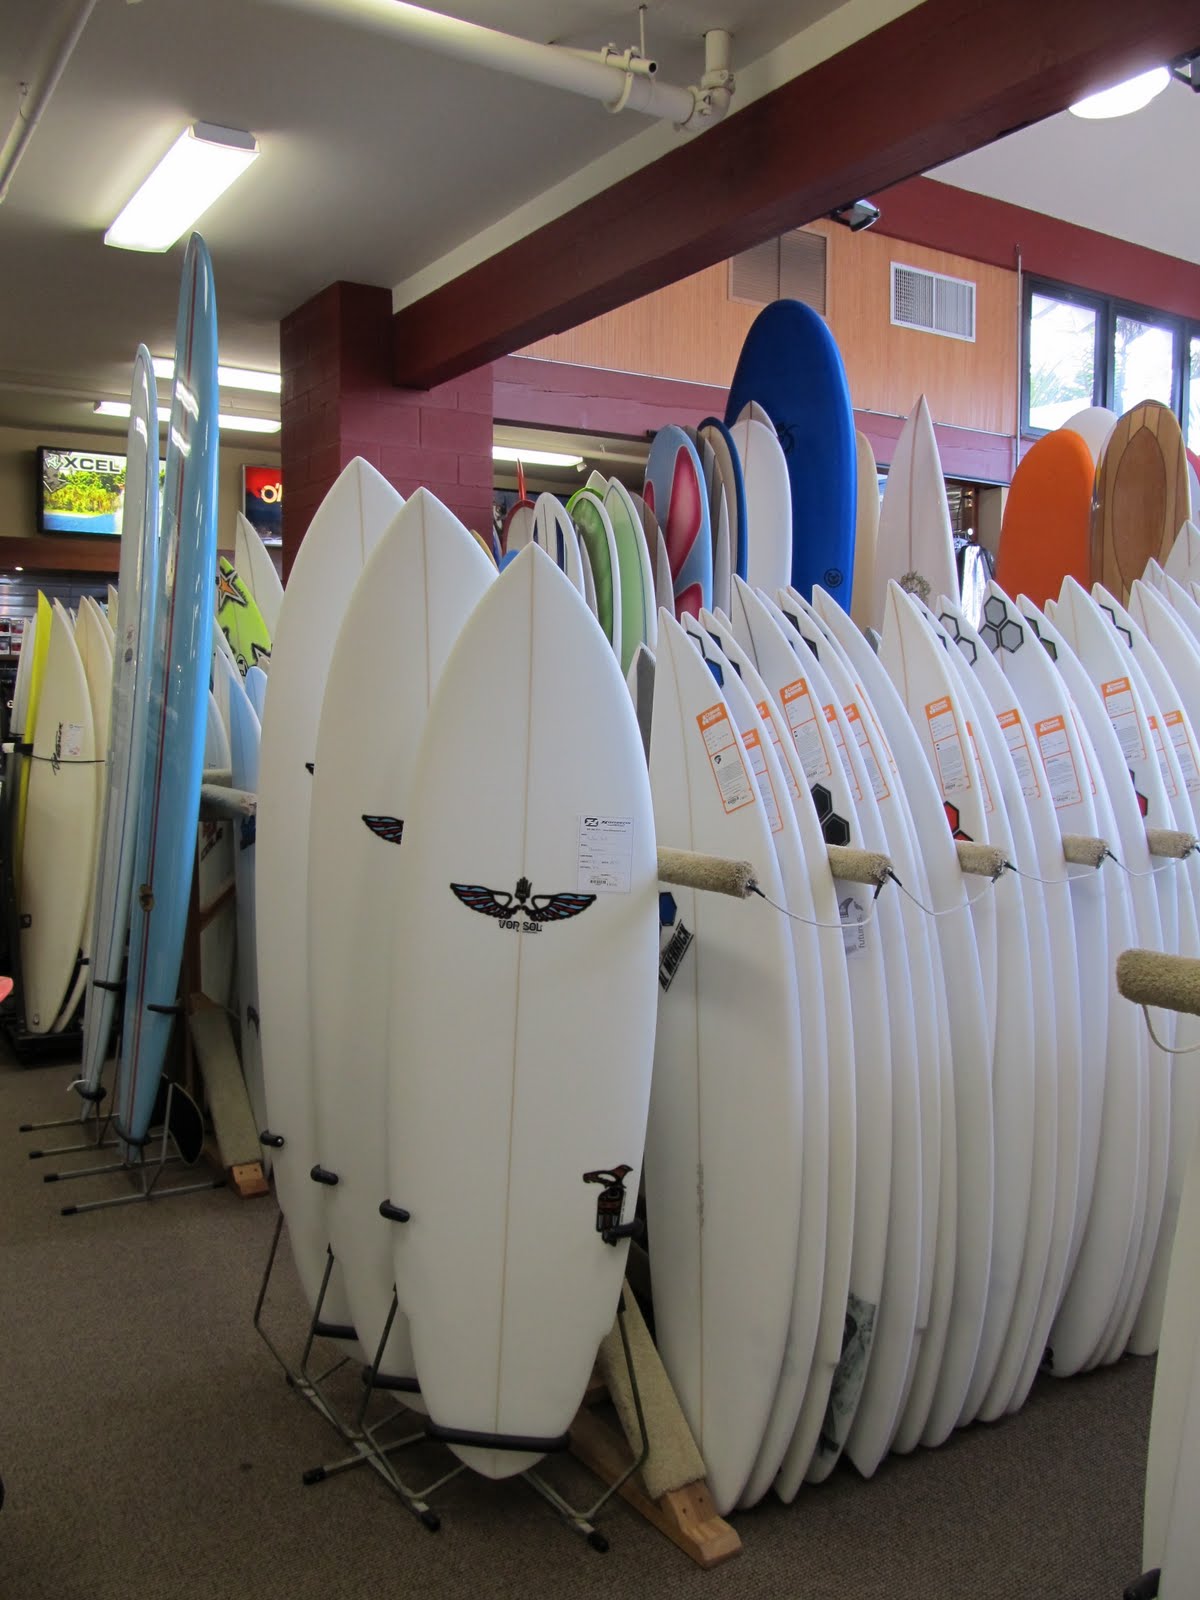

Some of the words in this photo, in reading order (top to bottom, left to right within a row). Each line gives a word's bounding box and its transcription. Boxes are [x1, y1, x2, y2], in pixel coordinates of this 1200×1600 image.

[63, 455, 120, 473] XCEL
[522, 920, 543, 932] SOL
[663, 922, 692, 976] MERRICK
